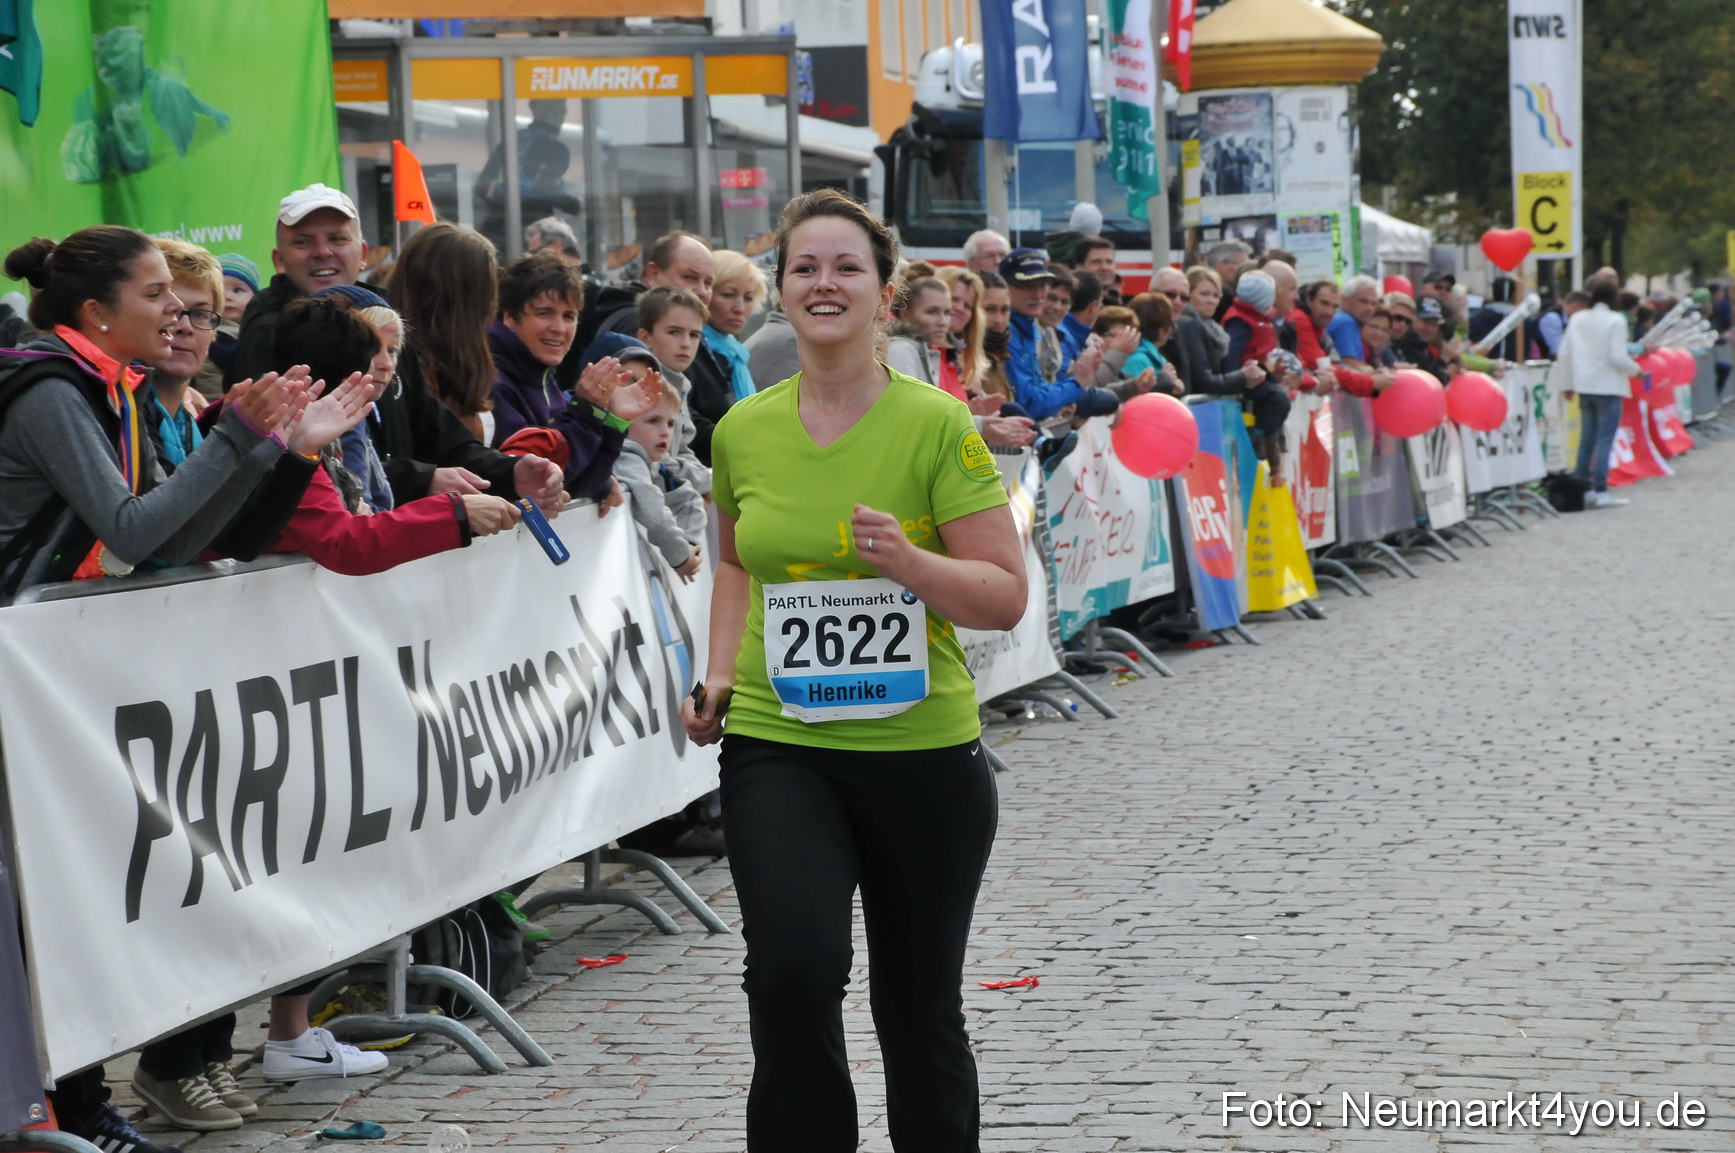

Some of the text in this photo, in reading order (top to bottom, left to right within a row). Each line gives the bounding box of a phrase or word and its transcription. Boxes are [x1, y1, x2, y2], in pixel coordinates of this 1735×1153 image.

[531, 65, 679, 92] RUNMARKT.DE
[1523, 174, 1567, 190] Block
[1530, 196, 1559, 235] C
[768, 592, 895, 610] PARTL Neumarkt
[781, 612, 912, 669] 2622
[808, 680, 887, 703] Henrike
[114, 594, 661, 924] PARTL Neumarkt
